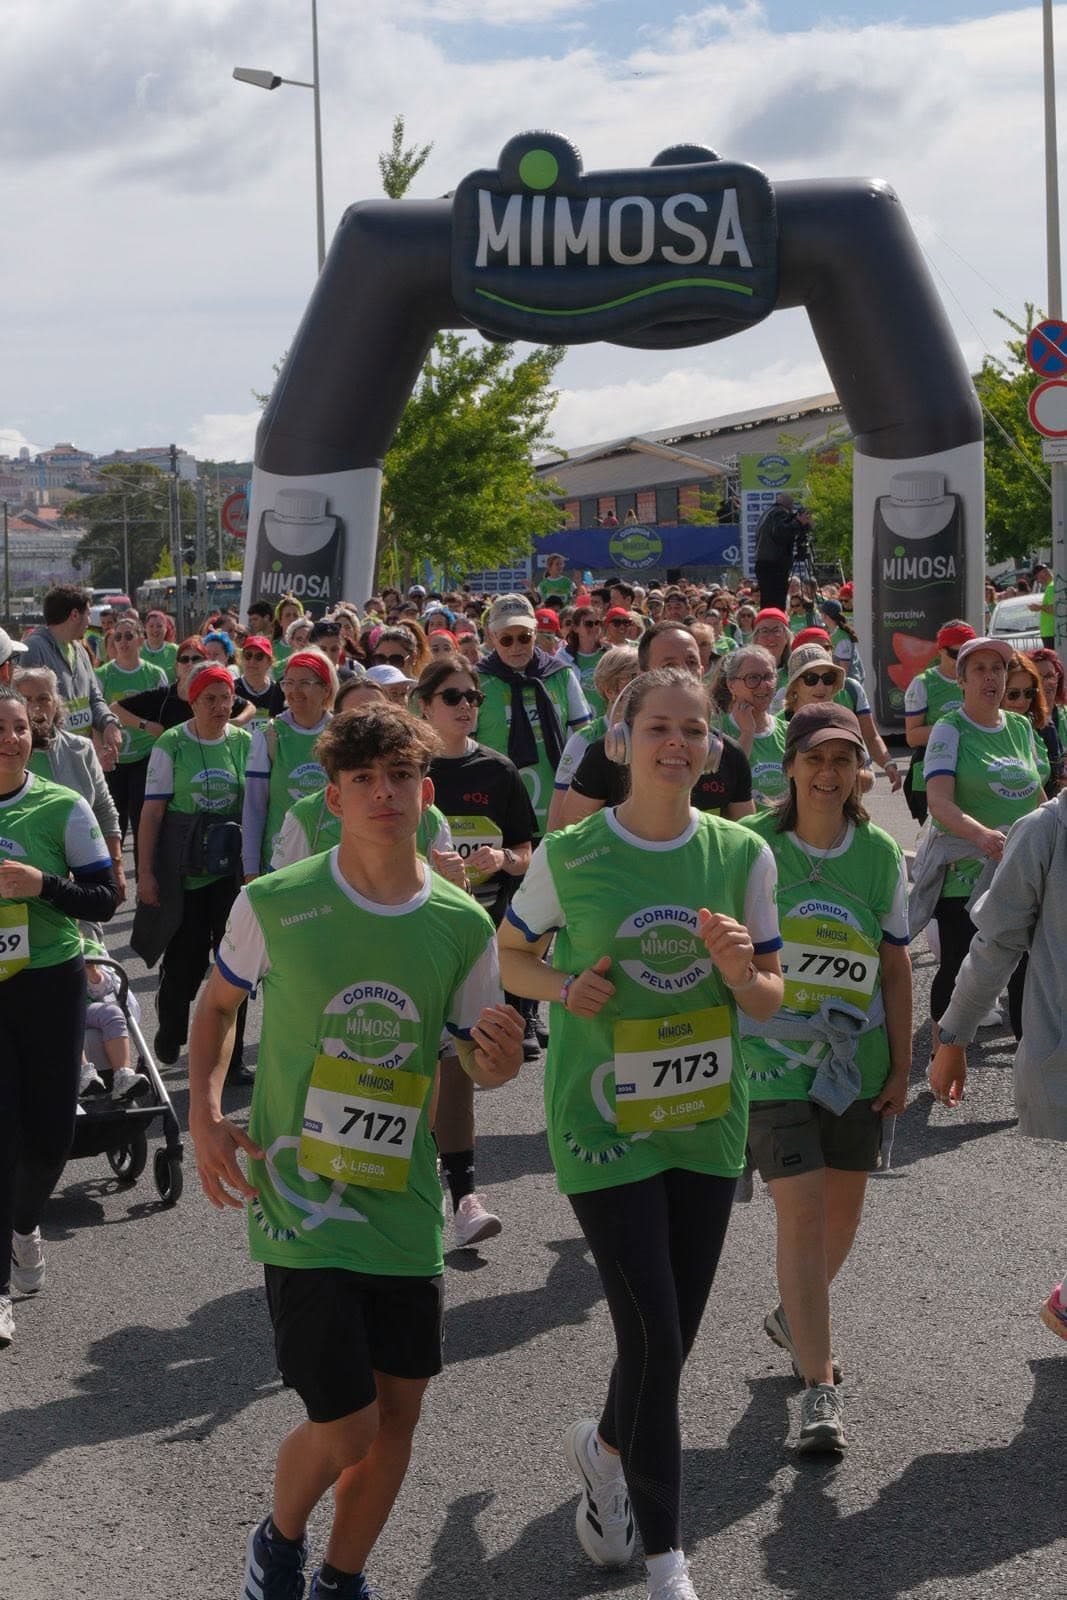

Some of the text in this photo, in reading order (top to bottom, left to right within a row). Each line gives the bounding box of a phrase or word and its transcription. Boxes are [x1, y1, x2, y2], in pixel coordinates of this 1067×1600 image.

[476, 187, 753, 268] MIMOSA
[882, 556, 956, 580] MIMOSA
[260, 572, 330, 598] MIMOSA
[883, 610, 926, 620] PROTEÍNA
[69, 712, 90, 726] 1570
[564, 849, 598, 870] luanvi
[280, 908, 318, 926] luanvi
[634, 909, 698, 929] CORRIDA
[800, 904, 849, 922] CORRIDA
[816, 928, 848, 942] MIMOSA
[640, 939, 698, 955] MIMOSA
[798, 953, 866, 982] 7790
[640, 966, 704, 990] PELA VIDA
[343, 986, 406, 1011] CORRIDA
[346, 1018, 400, 1038] MIMOSA
[658, 1022, 693, 1040] MIMOSA
[652, 1051, 719, 1088] 7173
[358, 1074, 394, 1092] MIMOSA
[670, 1100, 705, 1116] LISBOA
[339, 1106, 407, 1146] 7172
[350, 1159, 385, 1176] LISBOA
